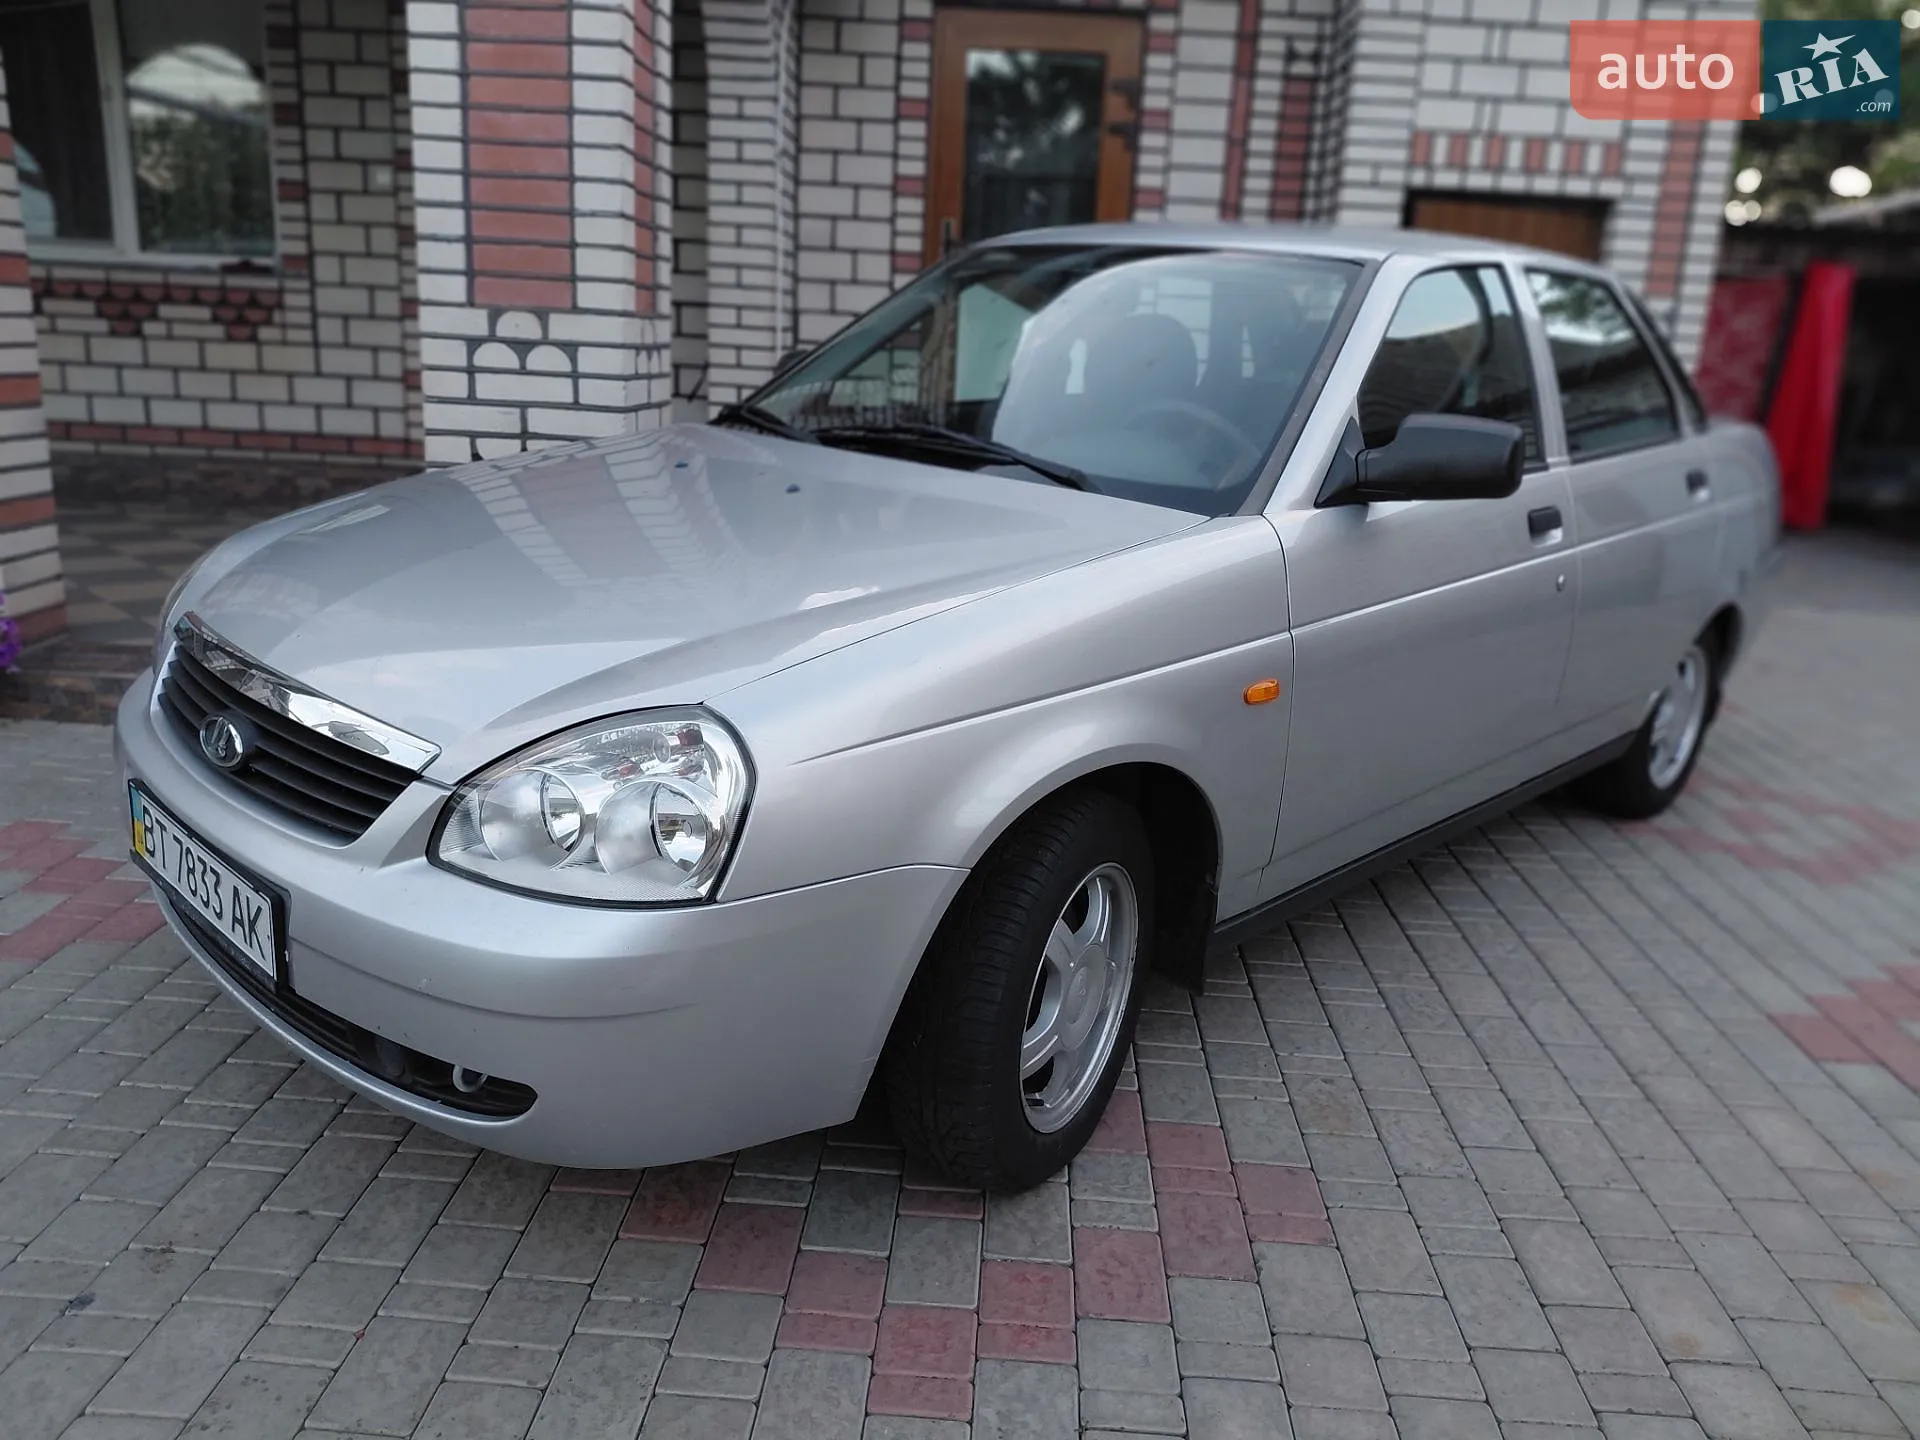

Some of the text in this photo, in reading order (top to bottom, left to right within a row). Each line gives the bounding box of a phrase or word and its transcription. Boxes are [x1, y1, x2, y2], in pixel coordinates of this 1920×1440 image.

[142, 804, 266, 961] BT 7833 AK
